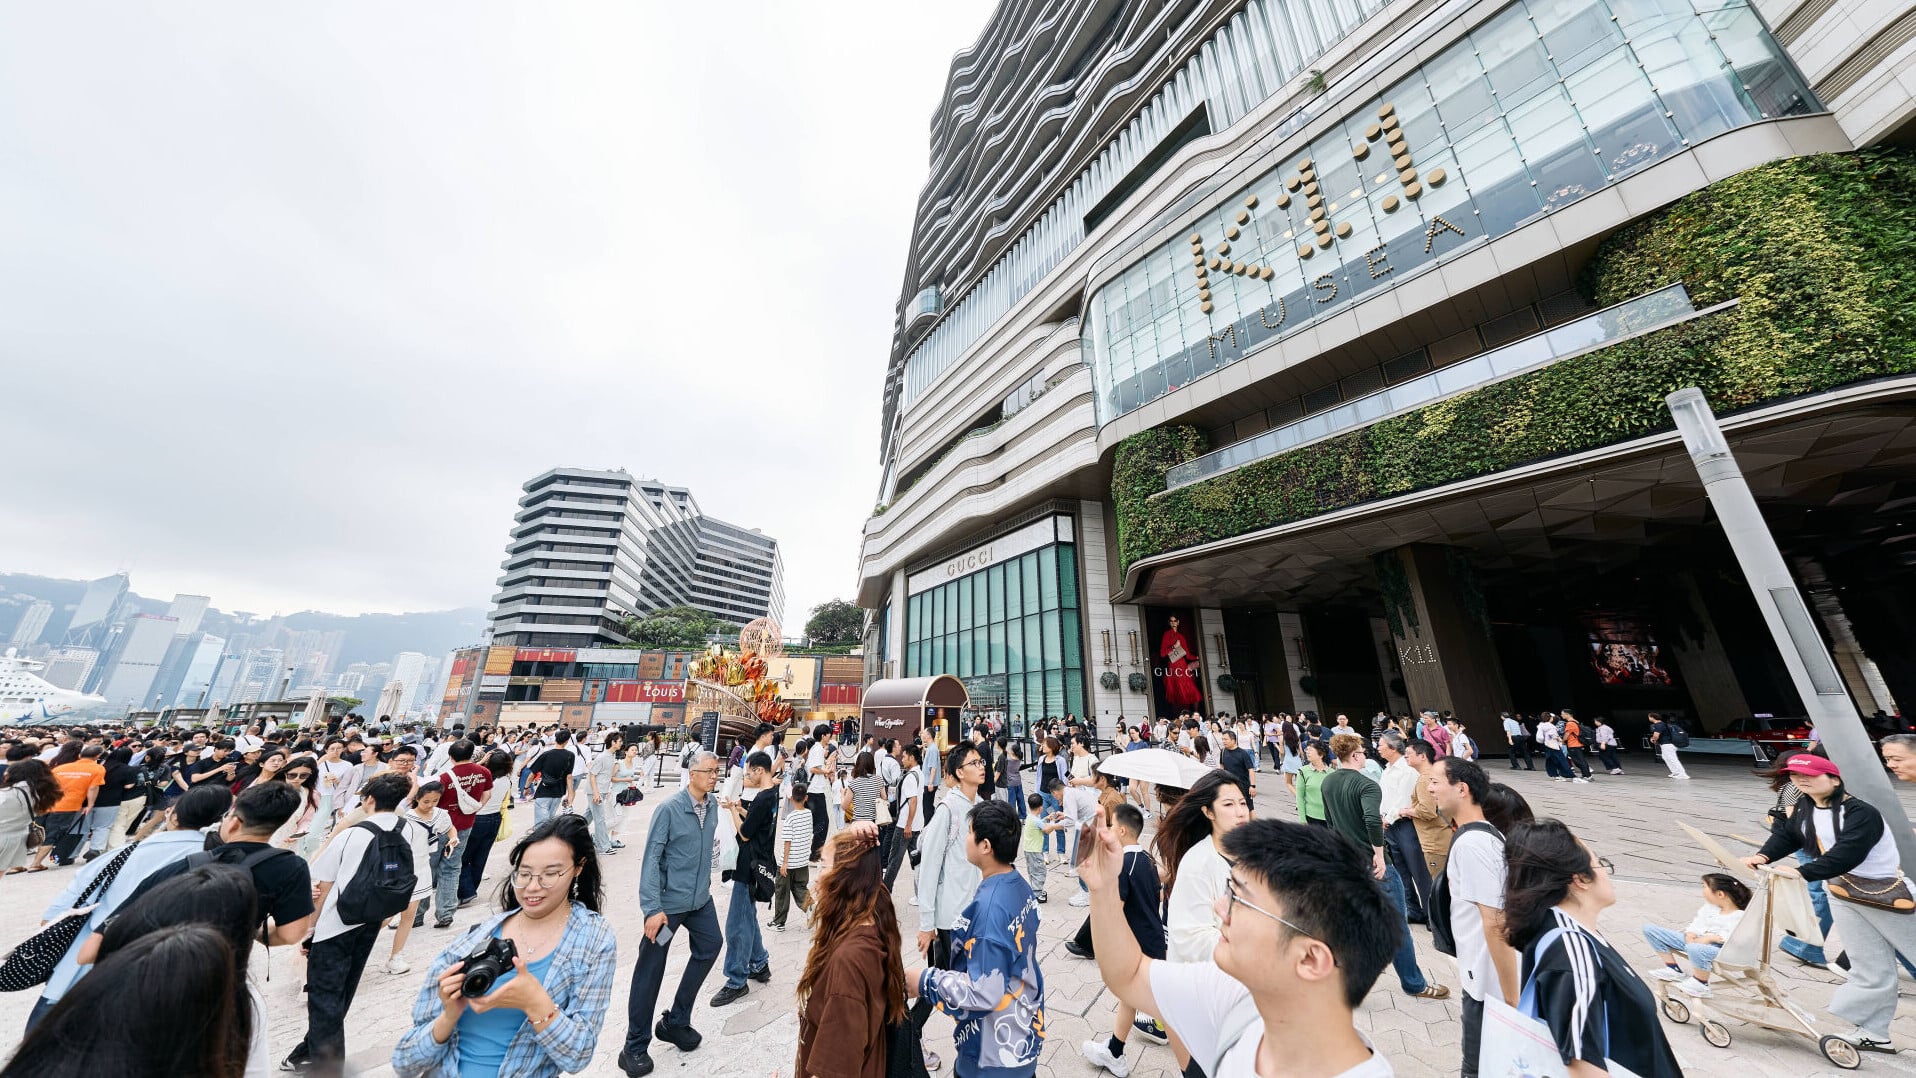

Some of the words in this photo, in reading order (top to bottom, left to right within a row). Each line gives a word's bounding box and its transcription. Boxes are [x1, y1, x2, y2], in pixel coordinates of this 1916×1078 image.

[1190, 102, 1446, 313] K11
[1207, 215, 1465, 358] MUSEA
[947, 546, 993, 576] GUCCI
[1399, 644, 1437, 665] K11
[1154, 667, 1199, 677] GUCCI
[646, 688, 678, 697] LOUIS
